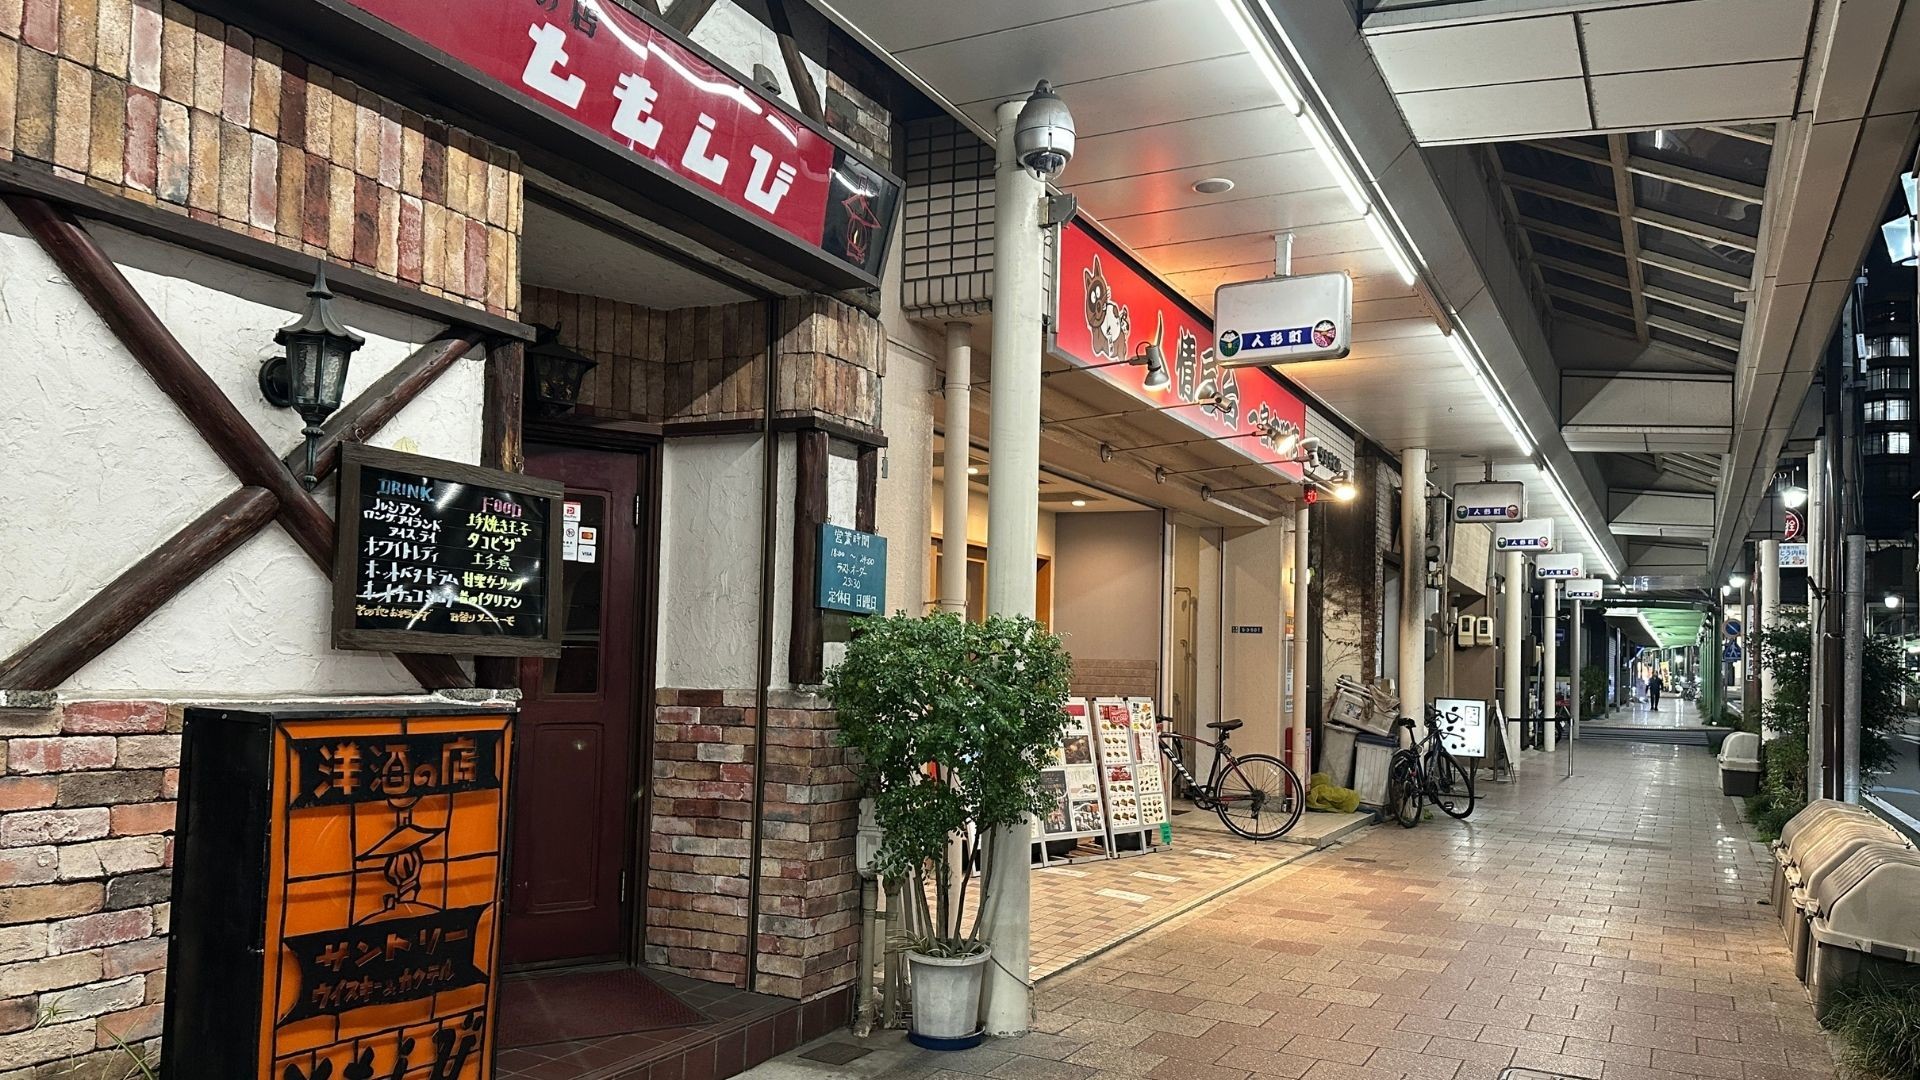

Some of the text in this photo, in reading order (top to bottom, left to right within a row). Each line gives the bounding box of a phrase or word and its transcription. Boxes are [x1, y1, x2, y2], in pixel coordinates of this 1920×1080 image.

[522, 22, 797, 214] ともしび
[1251, 330, 1302, 348] 人形町
[376, 479, 435, 502] DRINK
[481, 496, 522, 518] FOOD
[363, 536, 439, 562] ホワイトレディ
[467, 532, 522, 552] タコピザ
[834, 529, 870, 548] 営業時間
[470, 552, 513, 572] 土手煮
[828, 588, 877, 609] 定休日 日曜日
[314, 736, 481, 798] 洋酒の店
[315, 928, 468, 972] サントリー
